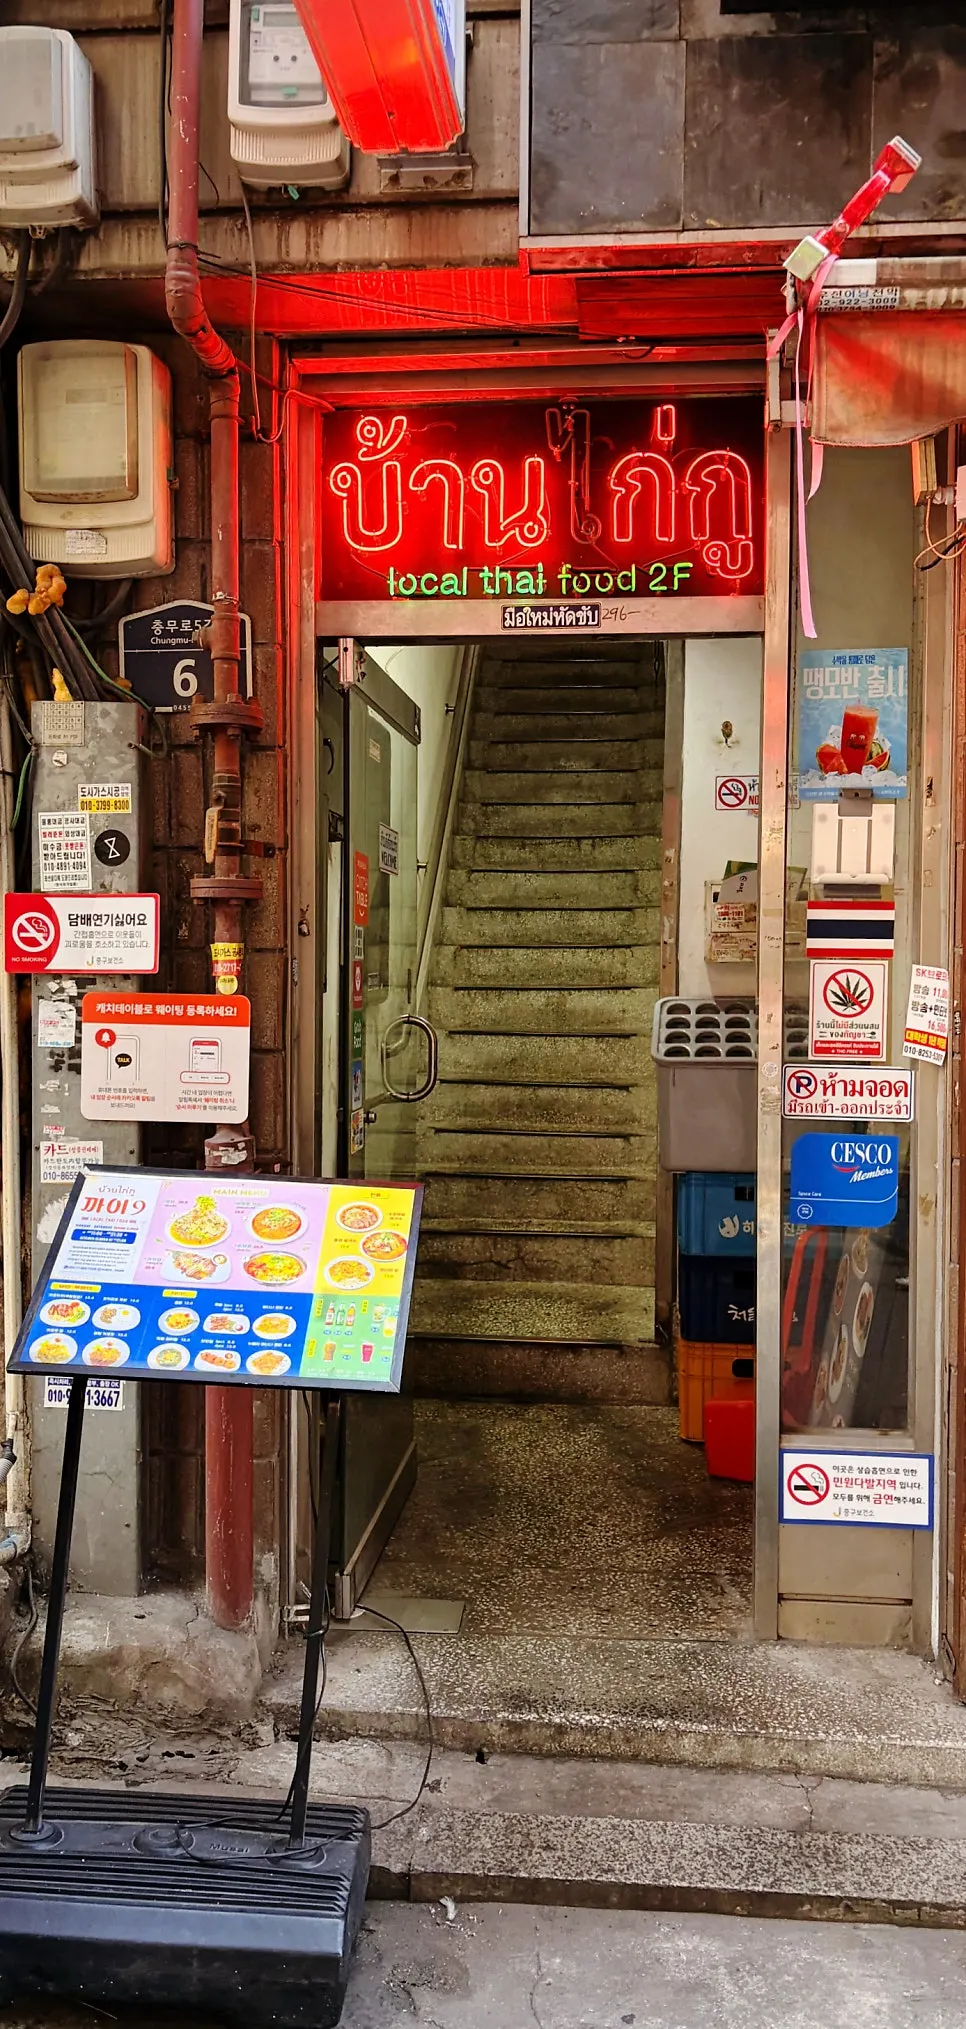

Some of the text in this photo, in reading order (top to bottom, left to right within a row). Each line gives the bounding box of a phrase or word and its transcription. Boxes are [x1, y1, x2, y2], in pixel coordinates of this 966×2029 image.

[387, 562, 694, 597] local thai food 2F
[503, 605, 599, 628] มือใหม่หัดขับ
[173, 658, 198, 697] 6
[803, 665, 904, 700] 땡모반 출시
[81, 786, 120, 797] 도시가스시공
[80, 800, 129, 811] 010-3799-8300
[68, 913, 148, 927] 담배연기싫어요
[95, 1003, 237, 1017] 캐치테이블로 웨이팅 등록하세요!
[819, 1072, 909, 1098] ห้ามจอด
[787, 1099, 909, 1116] มีรถเข้า-ออกประจำ
[44, 1143, 69, 1157] 카드
[831, 1141, 892, 1165] CESCO
[849, 1166, 894, 1183] Members
[832, 1465, 918, 1476] 이곳은 상습흡연으로 인한
[833, 1476, 897, 1490] 민원다발지역
[832, 1493, 854, 1502] 모두를
[856, 1494, 871, 1502] 위해
